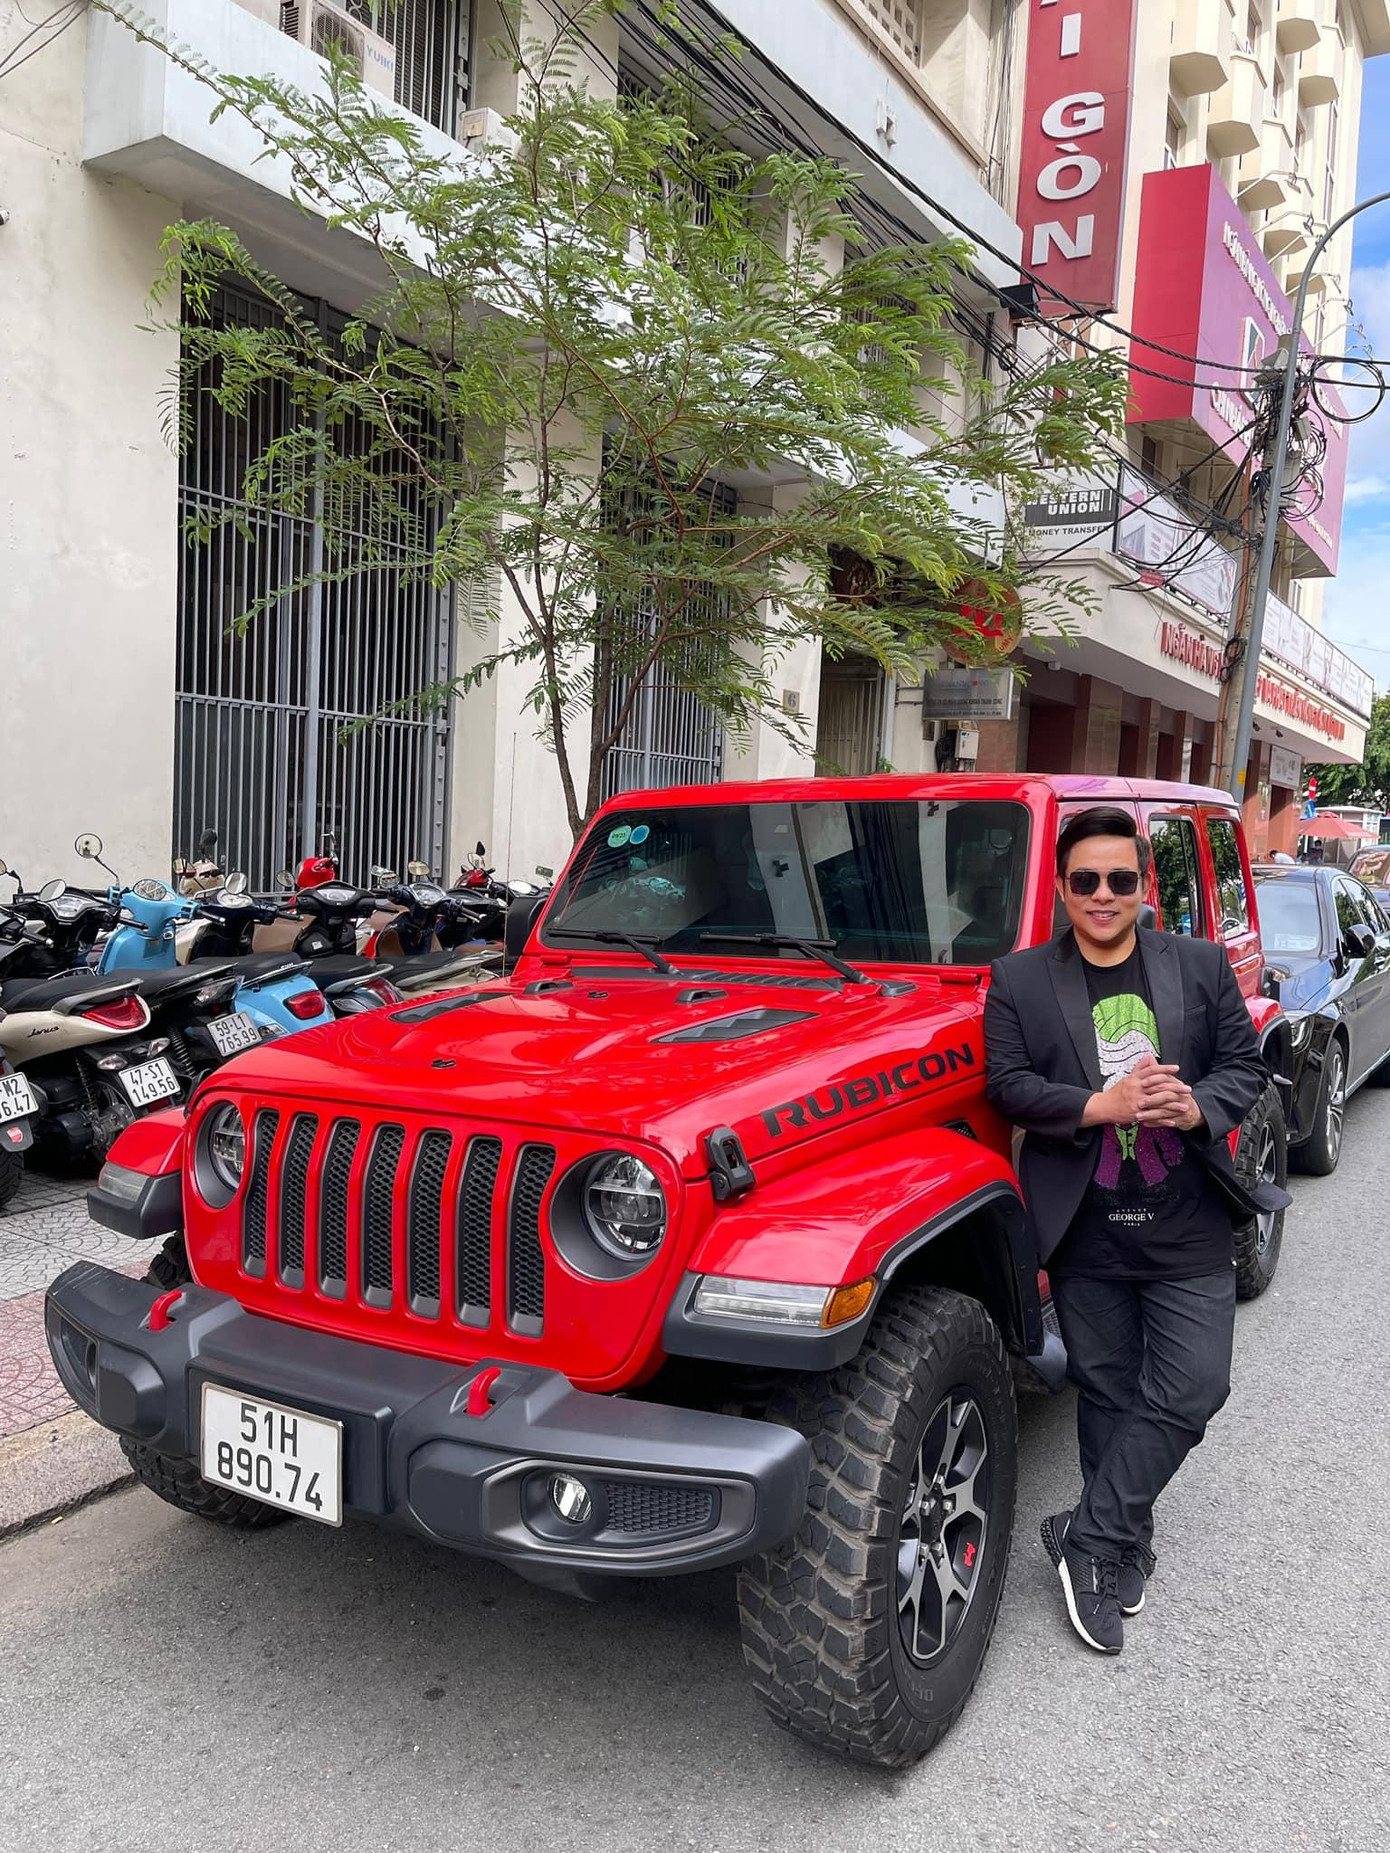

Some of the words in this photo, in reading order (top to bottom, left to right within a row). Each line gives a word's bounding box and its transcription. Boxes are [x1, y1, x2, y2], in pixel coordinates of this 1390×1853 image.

[1031, 91, 1105, 266] GÒN
[1048, 501, 1100, 515] UNION
[215, 1014, 247, 1037] 59-L1
[219, 1027, 257, 1053] 765.99
[130, 1063, 164, 1085] 47-S1
[132, 1076, 176, 1103] 149.56
[760, 1043, 975, 1137] RUBICON
[1108, 1213, 1147, 1221] GEORGE
[1147, 1212, 1154, 1220] V
[240, 1402, 297, 1458] 51H
[217, 1440, 323, 1512] 890.74
